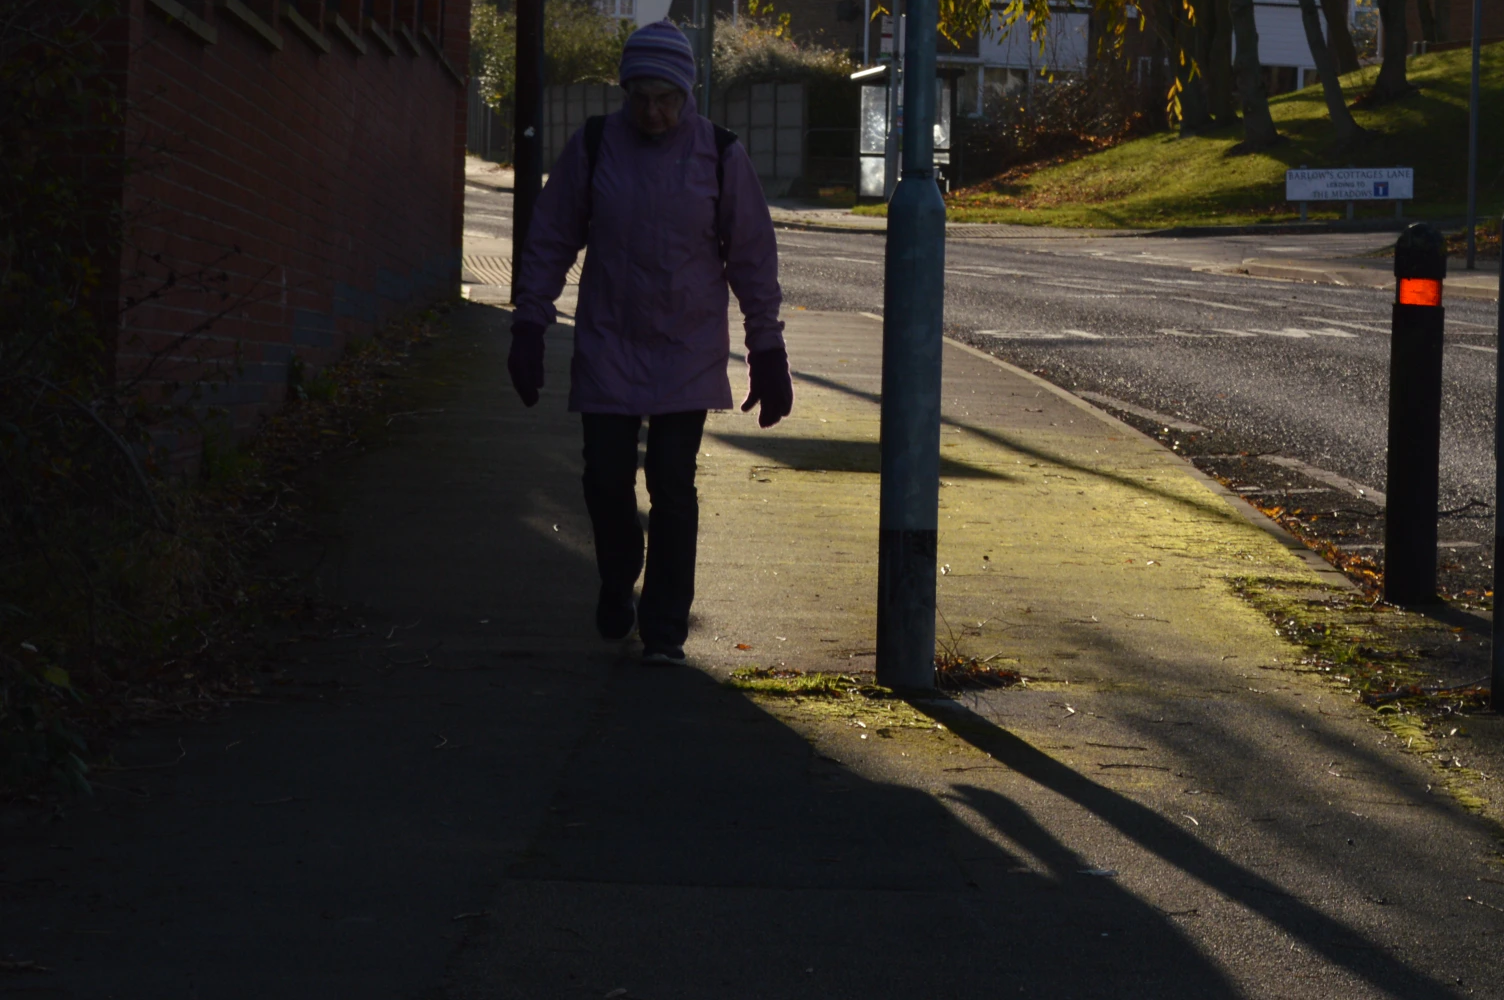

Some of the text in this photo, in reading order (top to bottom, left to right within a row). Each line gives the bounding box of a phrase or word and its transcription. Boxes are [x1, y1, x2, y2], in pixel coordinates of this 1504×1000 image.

[1337, 170, 1384, 180] COTTAGES
[1387, 169, 1411, 179] LANE
[1312, 189, 1373, 199] THE MEADOWS
